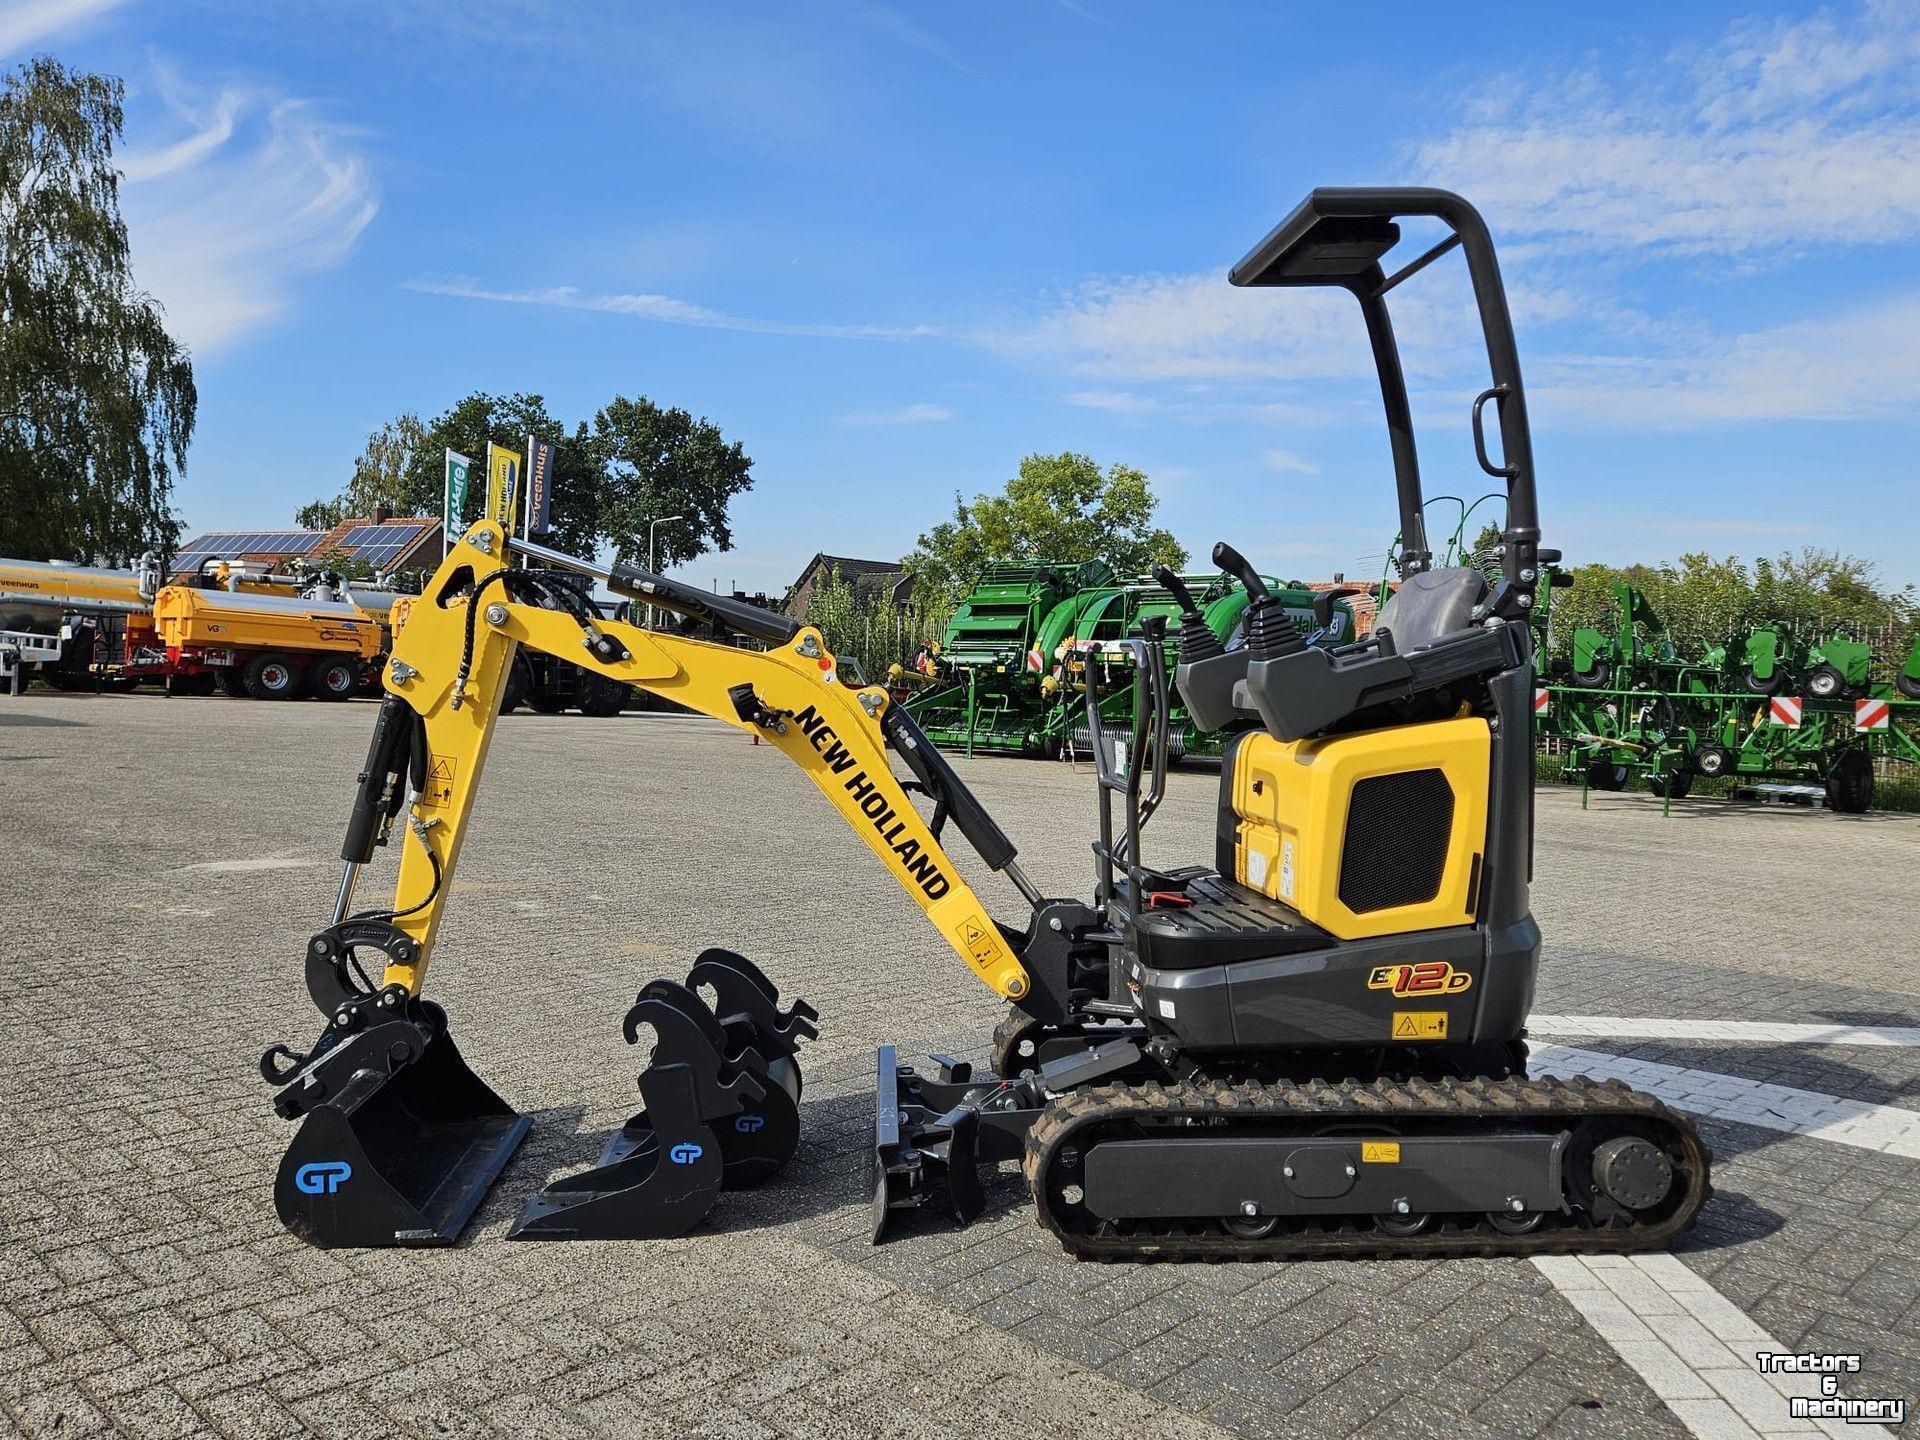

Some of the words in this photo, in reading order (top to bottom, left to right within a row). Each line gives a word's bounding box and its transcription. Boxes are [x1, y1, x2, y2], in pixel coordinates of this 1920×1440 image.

[793, 704, 857, 774] NEW
[844, 771, 950, 901] HOLLAND
[1370, 961, 1471, 995] E12D
[735, 1115, 764, 1133] GP
[670, 1143, 703, 1164] GP
[295, 1161, 352, 1194] GP
